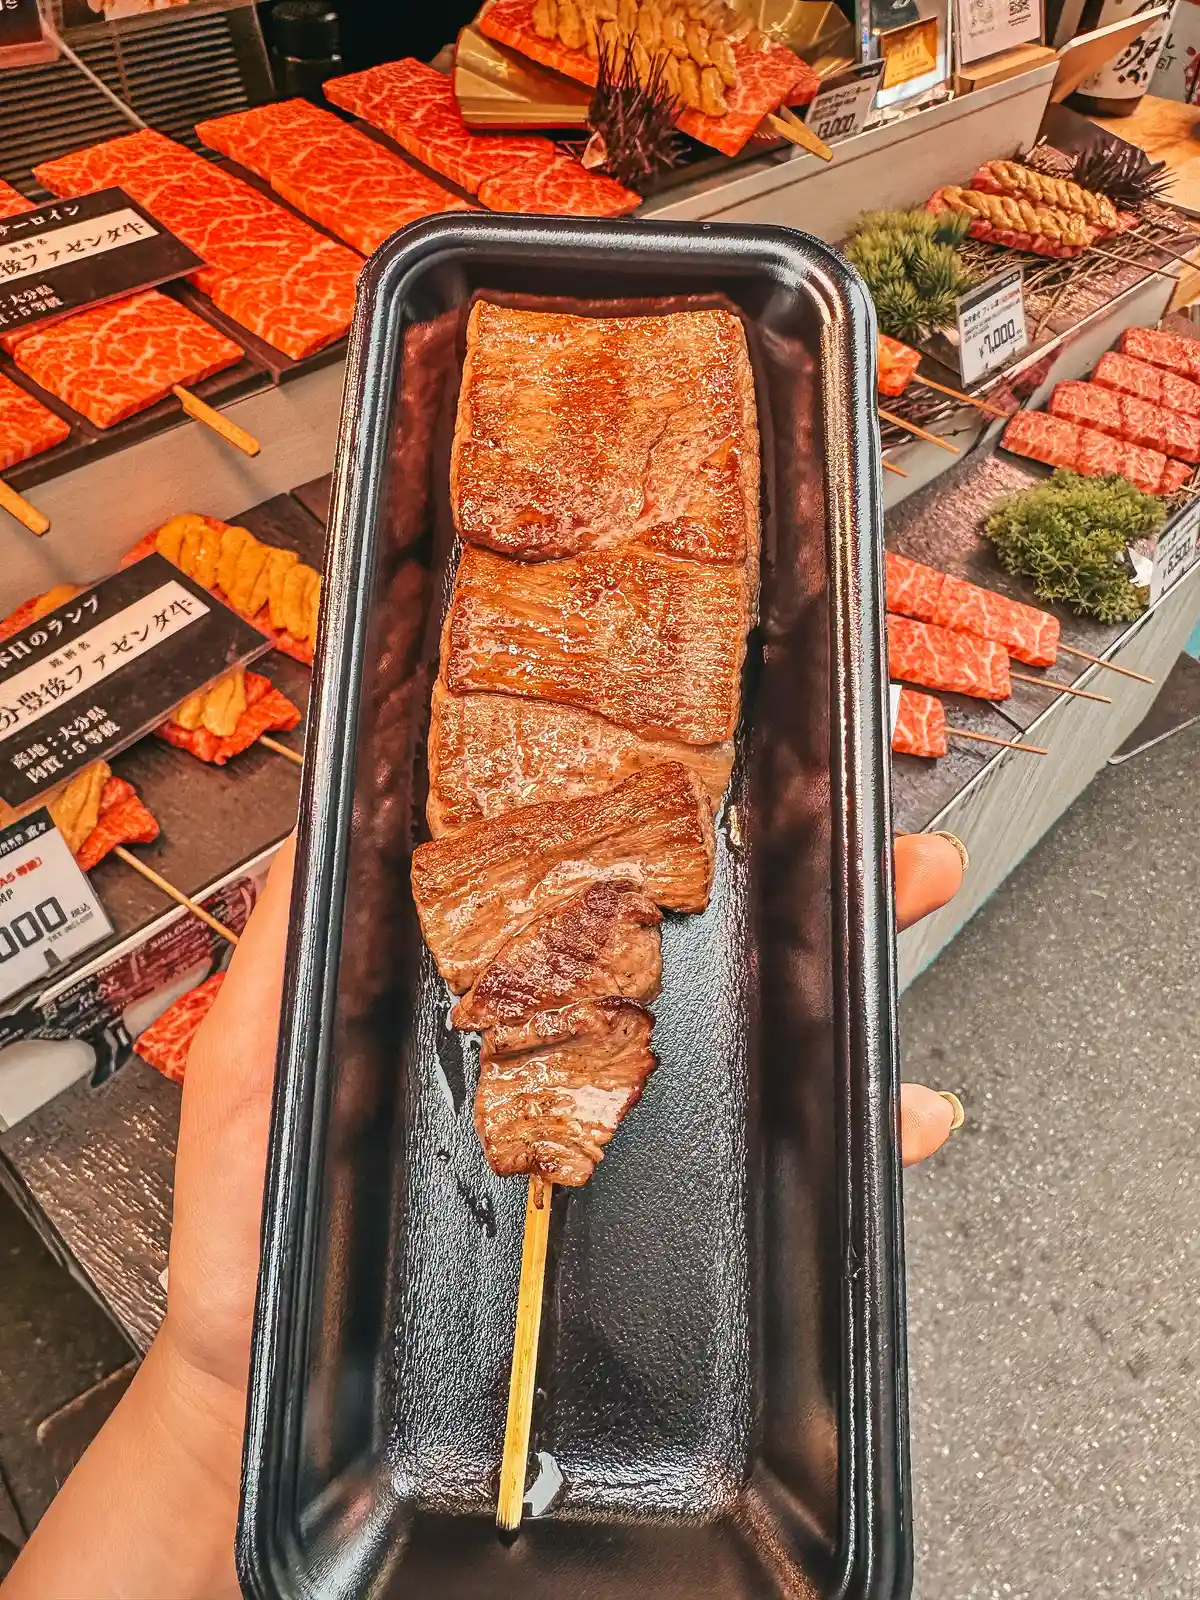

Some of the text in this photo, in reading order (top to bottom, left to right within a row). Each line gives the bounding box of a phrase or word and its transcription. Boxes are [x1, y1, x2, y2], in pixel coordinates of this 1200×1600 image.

[0, 221, 144, 279] 後ファゼンダ牛
[0, 598, 194, 731] 分豊後ファゼンダ牛
